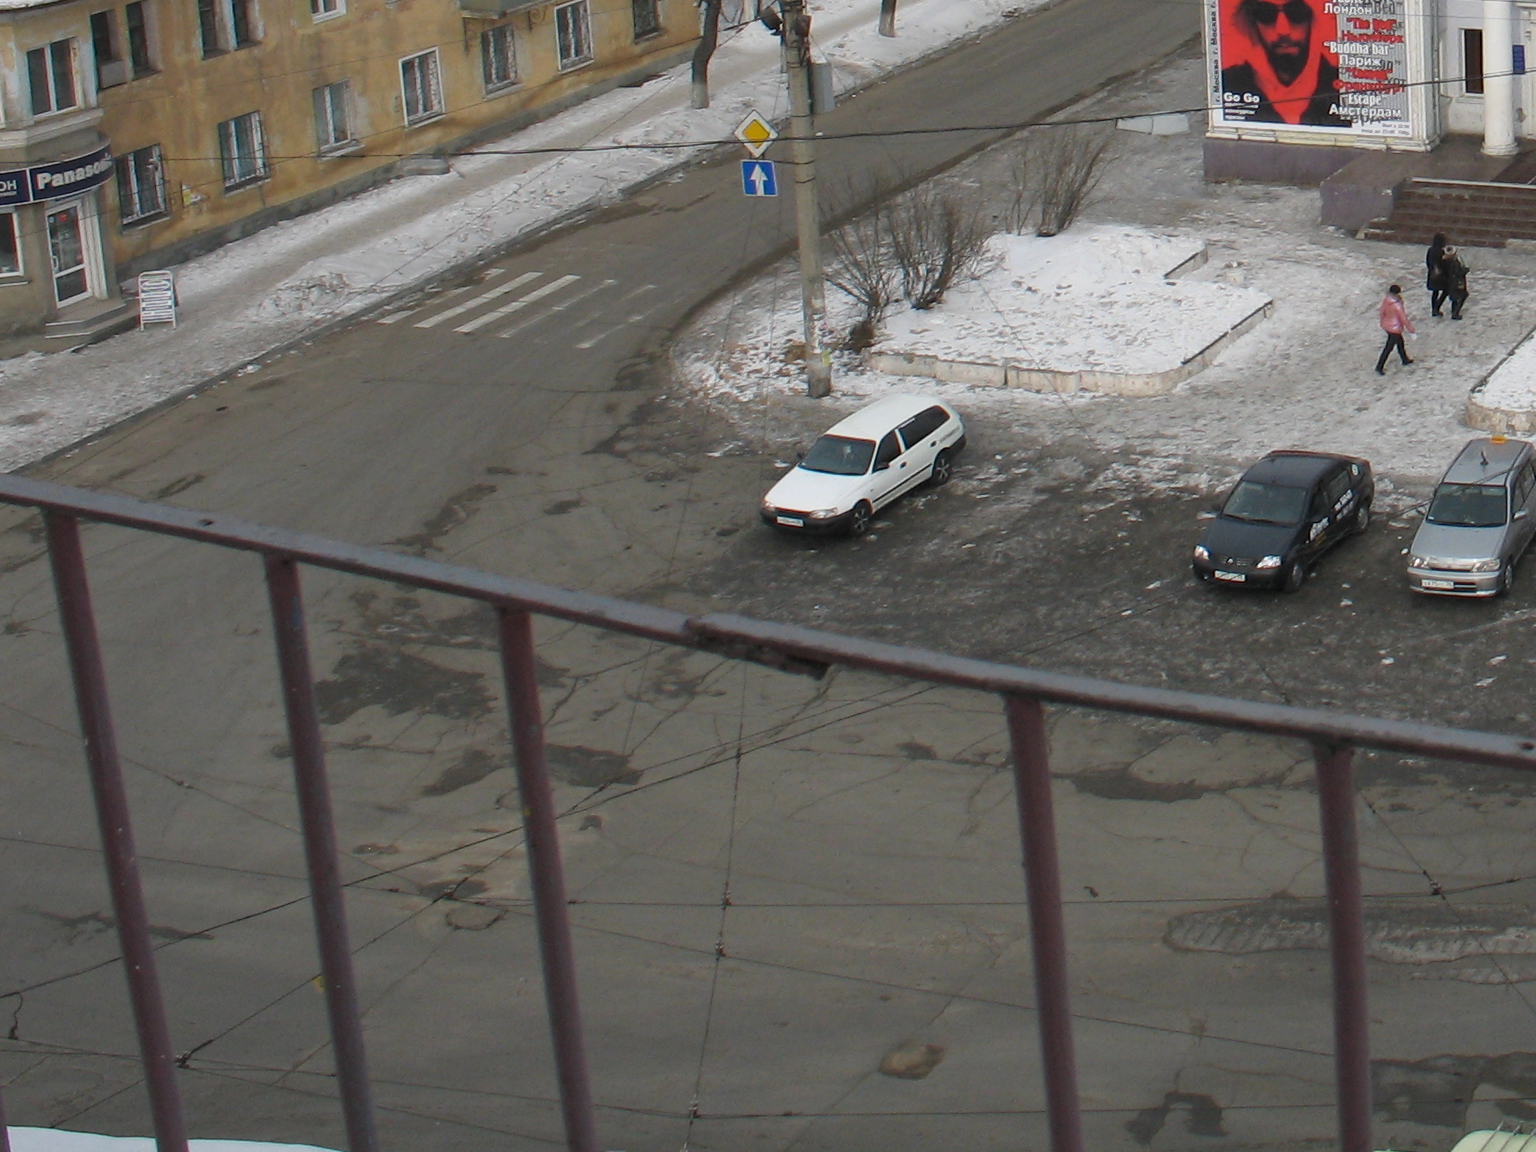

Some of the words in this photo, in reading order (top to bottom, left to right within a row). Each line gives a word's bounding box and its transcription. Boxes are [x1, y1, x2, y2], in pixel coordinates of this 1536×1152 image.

[1324, 2, 1372, 15] Лондон
[1340, 54, 1382, 68] Париж
[1223, 92, 1240, 102] Go
[1243, 93, 1260, 103] Go
[1329, 103, 1401, 118] Амстердам
